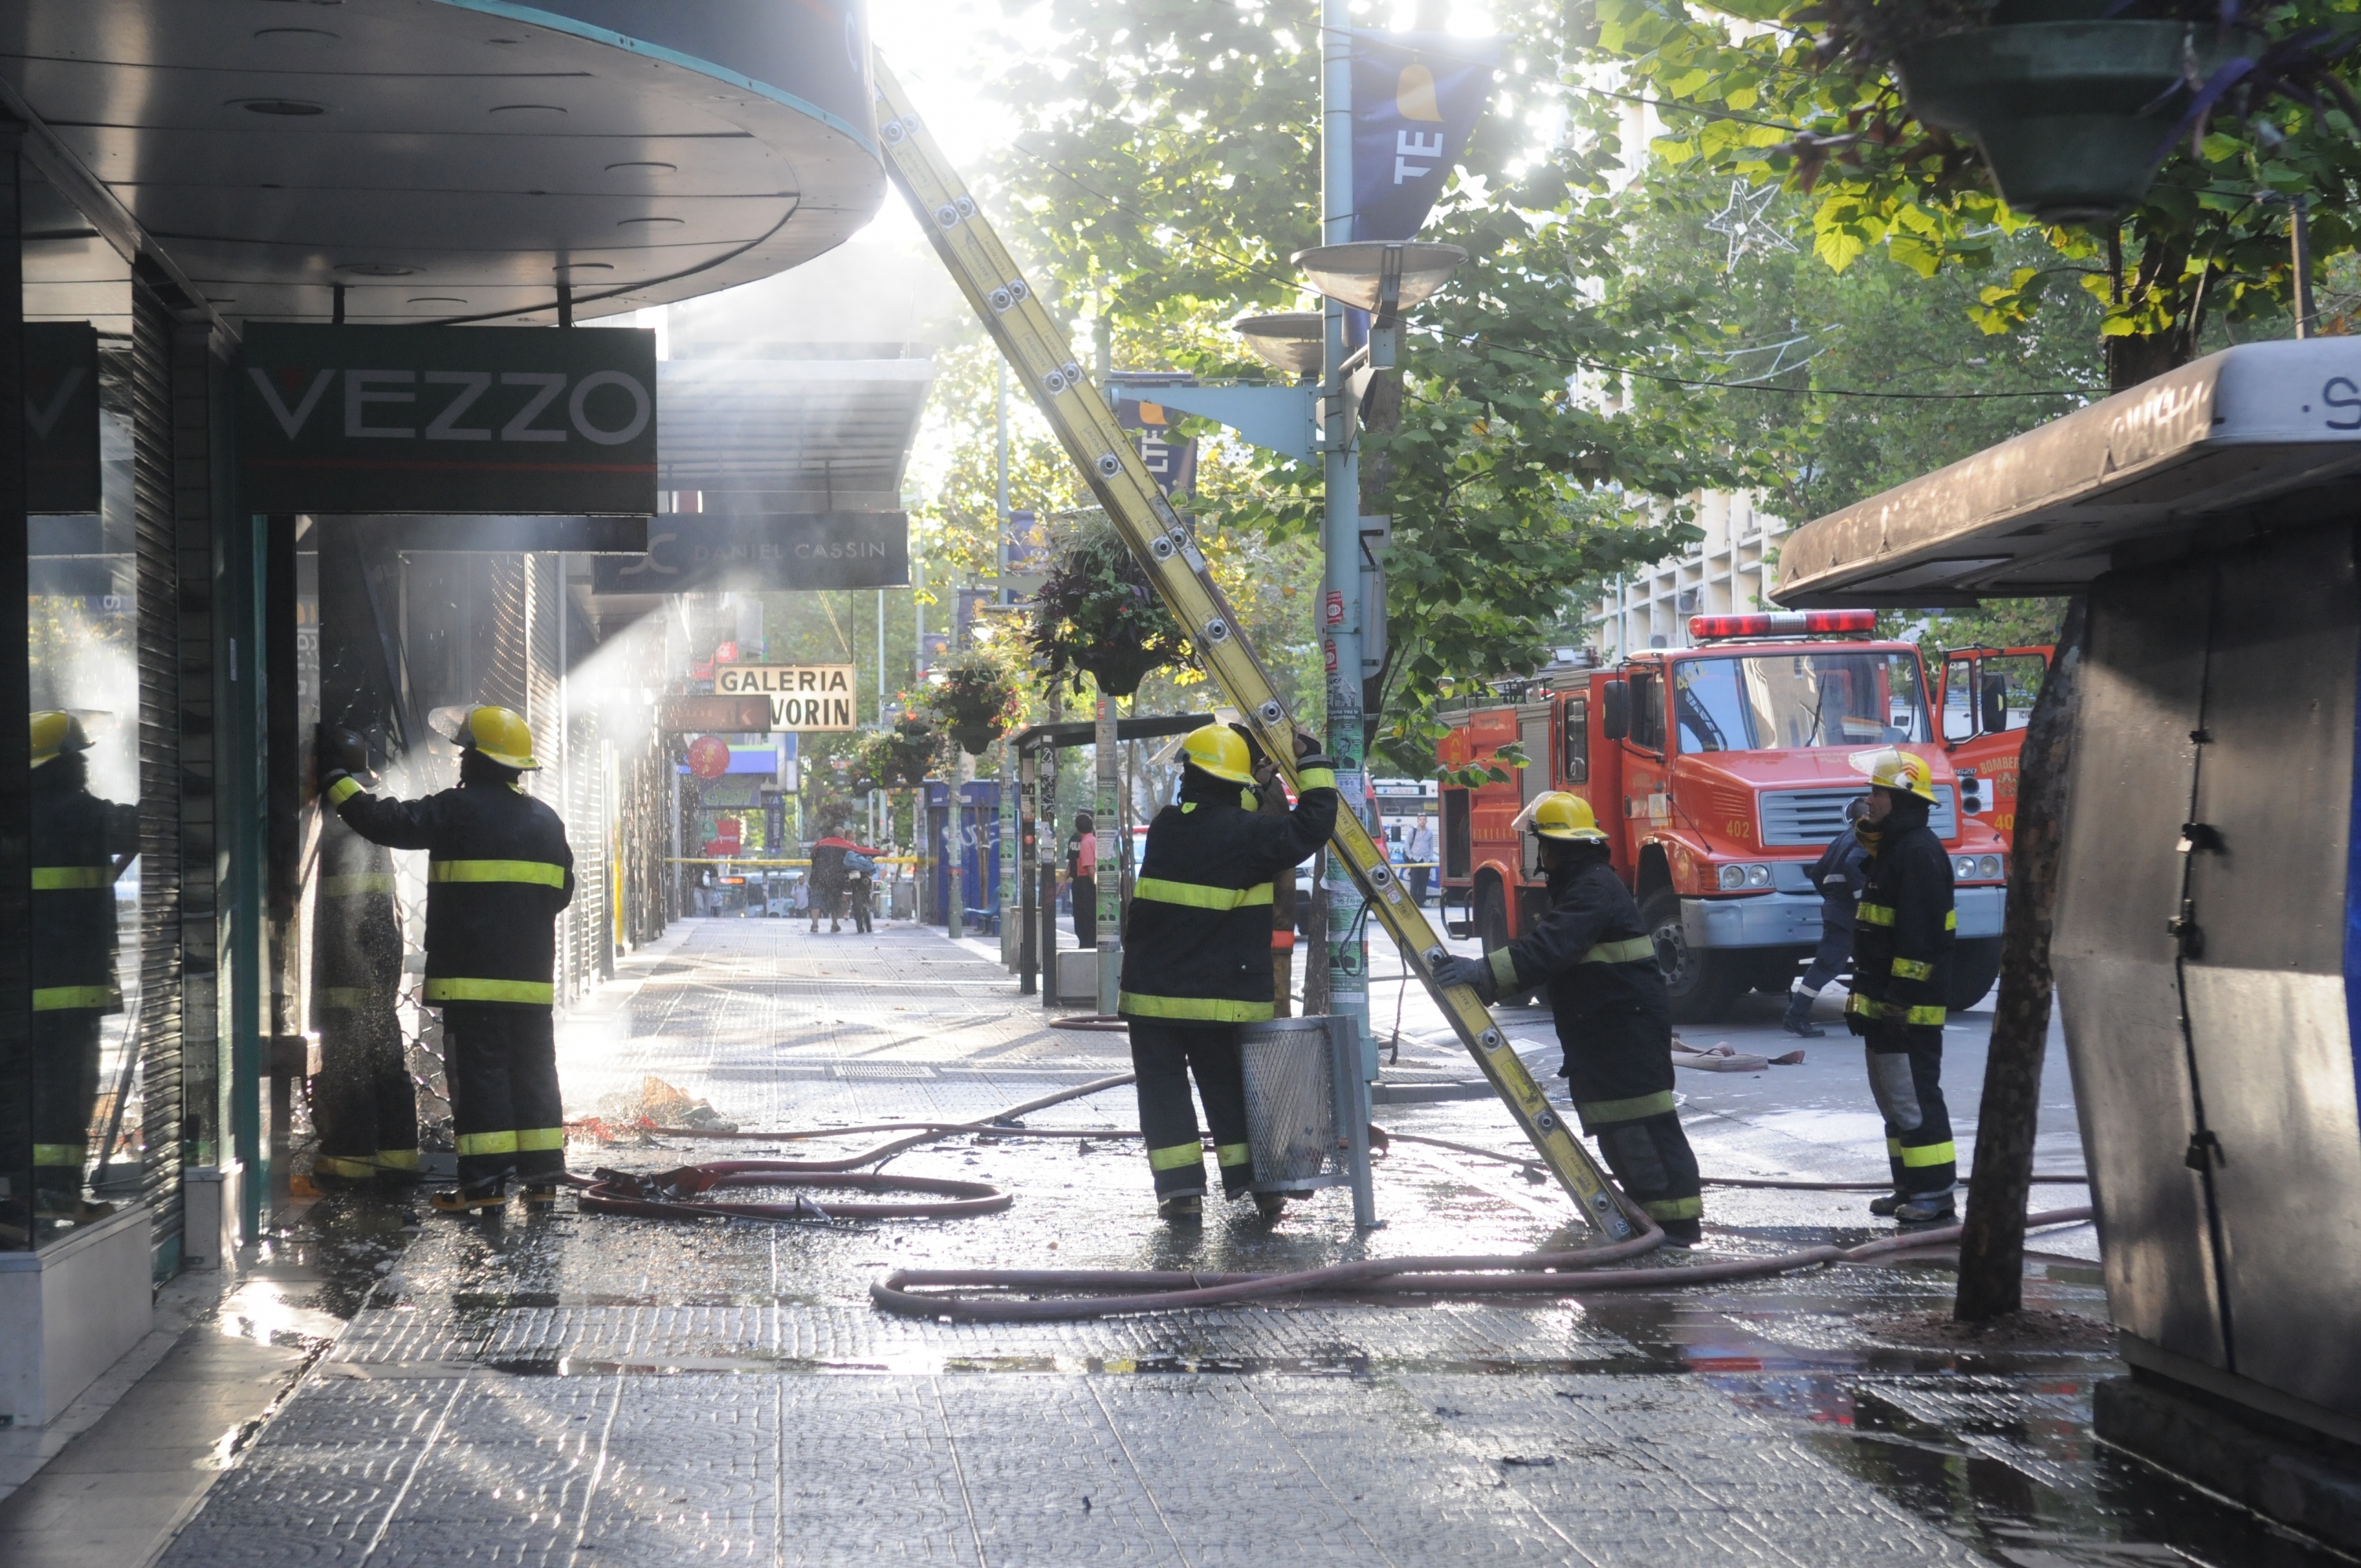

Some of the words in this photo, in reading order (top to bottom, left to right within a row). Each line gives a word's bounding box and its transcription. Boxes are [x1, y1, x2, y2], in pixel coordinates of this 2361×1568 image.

[967, 245, 990, 277] ALCO-LITE
[984, 240, 1006, 272] ALCO-LITE
[1025, 337, 1047, 368] ALCO-LITE
[247, 367, 652, 446] VEZZO
[1102, 422, 1125, 454] ALCO-LITE
[695, 542, 784, 561] DANIEL
[794, 541, 885, 559] CASSIN
[720, 670, 848, 692] GALERIA
[1676, 662, 1709, 690] 402
[770, 699, 850, 726] VORIN
[1726, 820, 1750, 838] 402
[1617, 1220, 1629, 1233] 28
